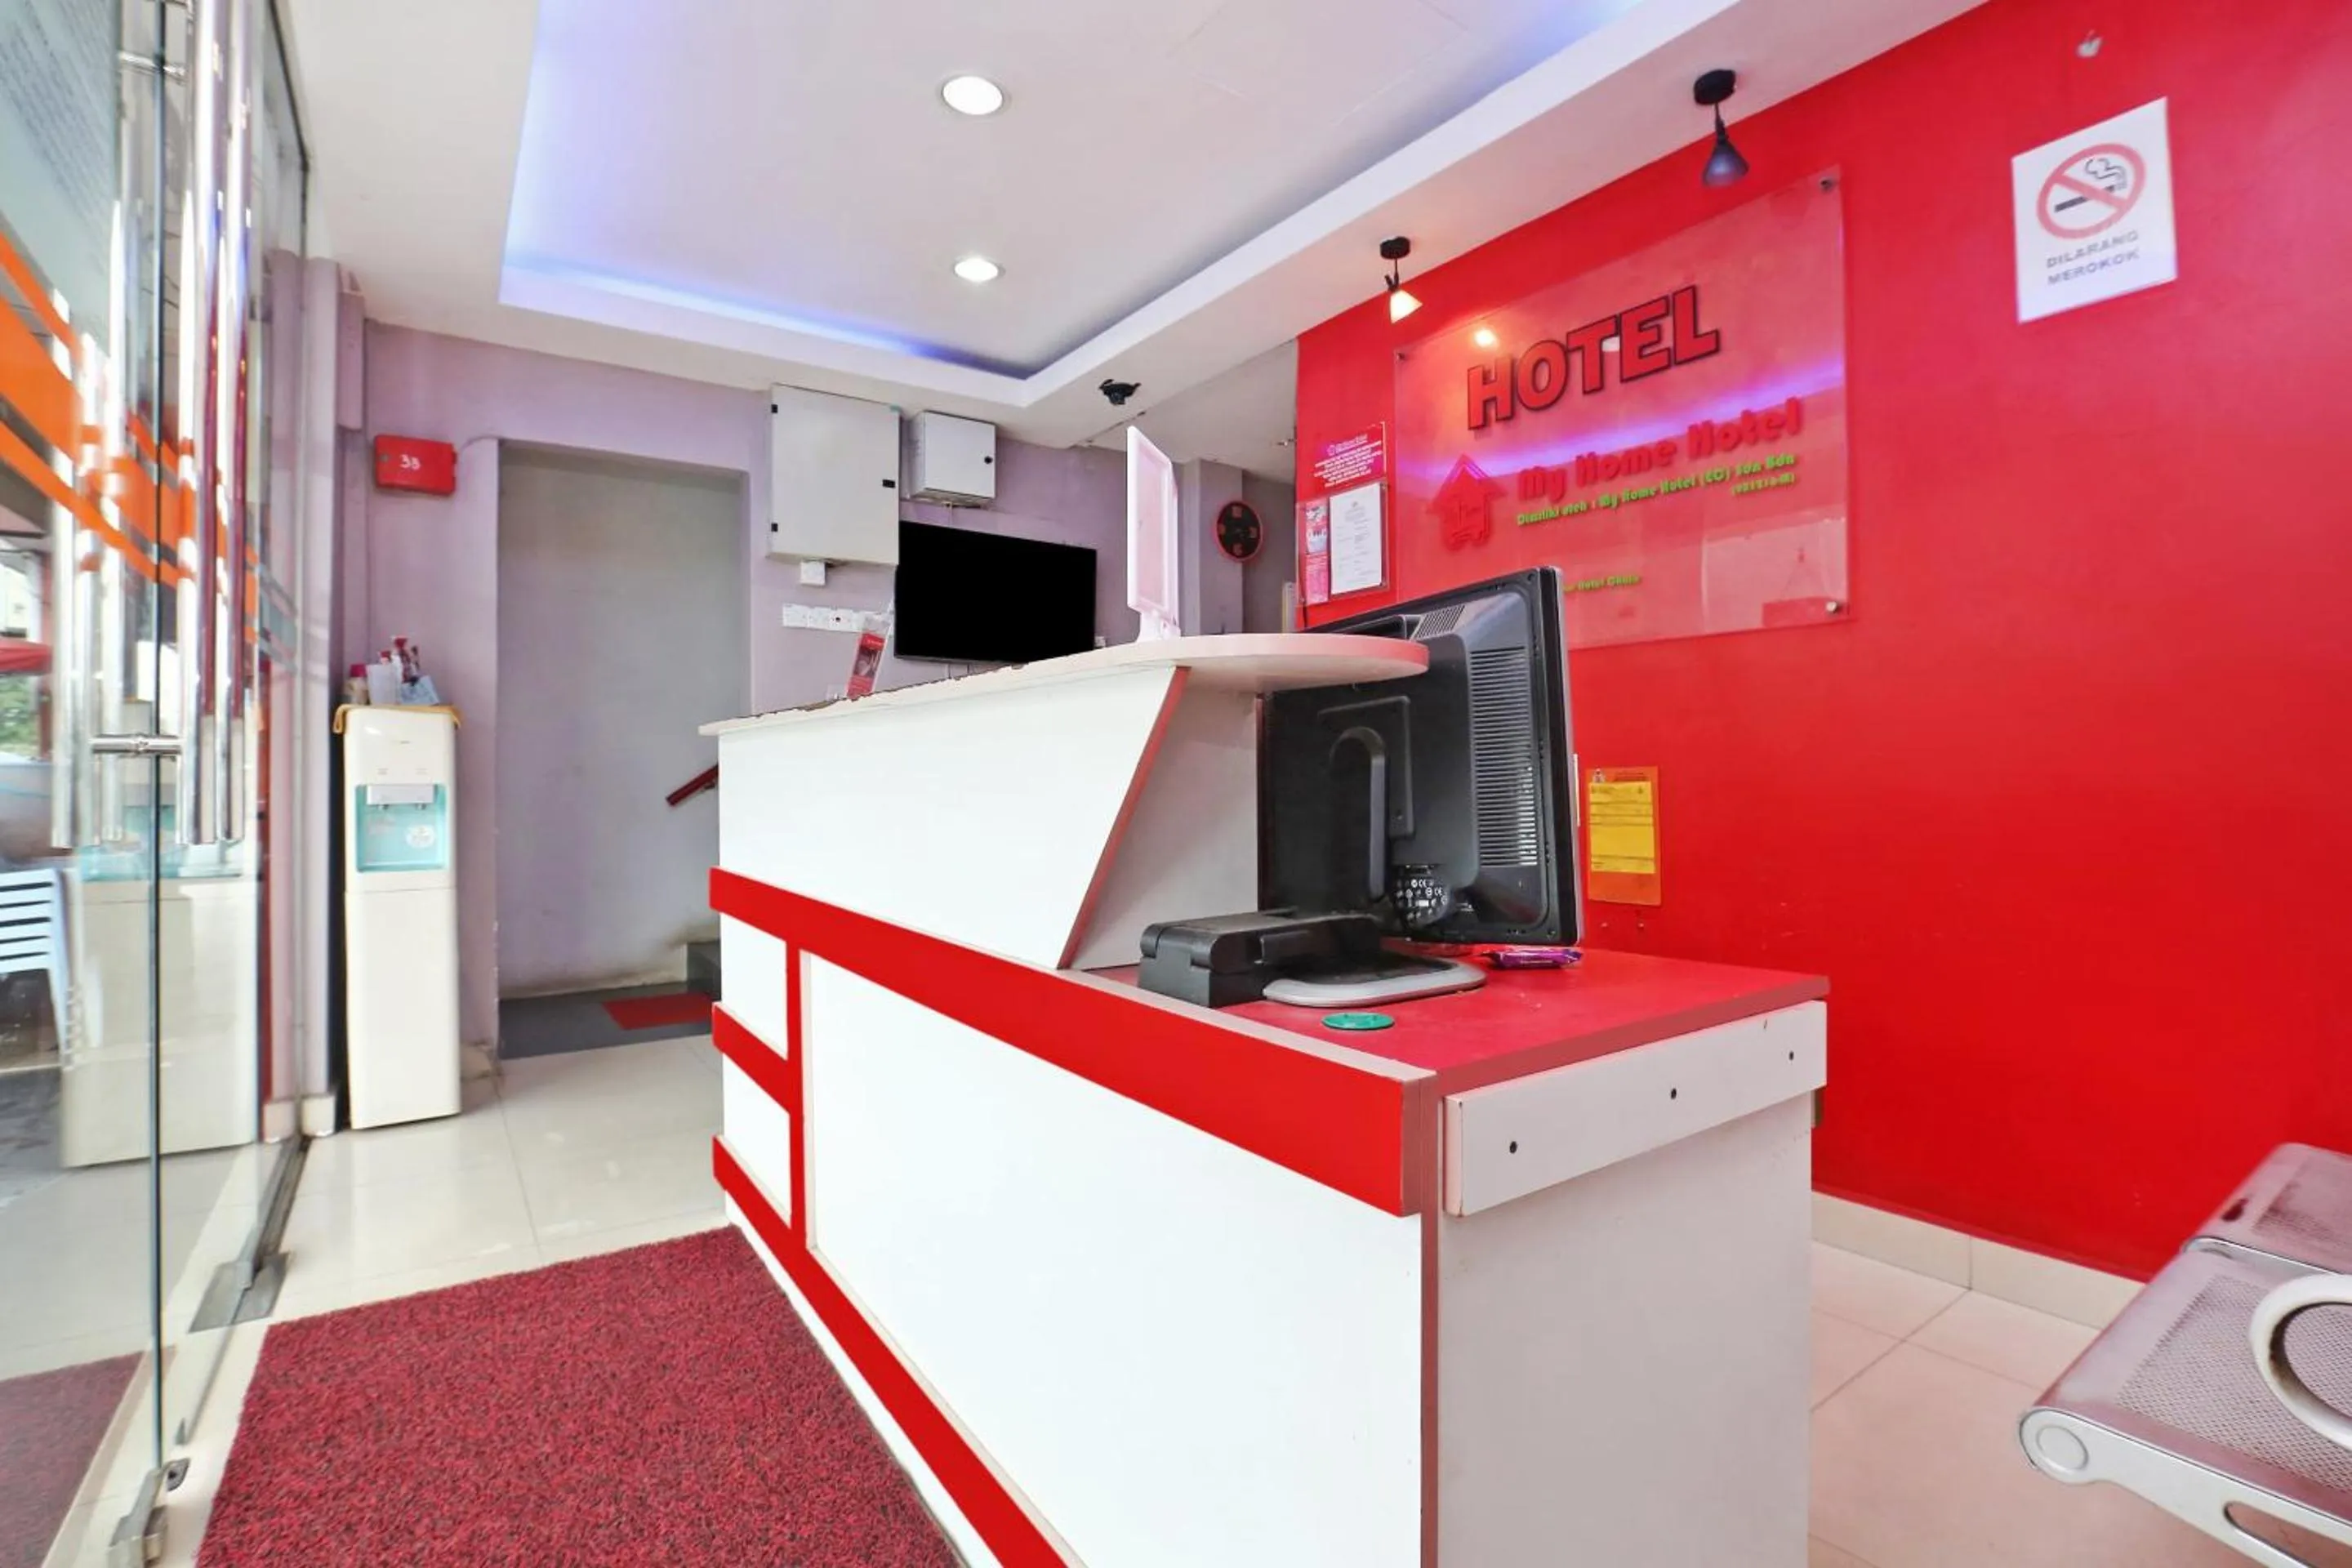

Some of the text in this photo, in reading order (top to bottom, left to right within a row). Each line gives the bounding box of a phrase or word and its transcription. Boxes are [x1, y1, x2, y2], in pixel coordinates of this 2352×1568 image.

[2046, 229, 2139, 269] DILARANG
[2047, 248, 2139, 284] MEROKOK
[1468, 285, 1720, 430] HOTEL
[1518, 466, 1566, 502] My
[1575, 440, 1677, 488] Home
[1687, 397, 1802, 459] Hotel
